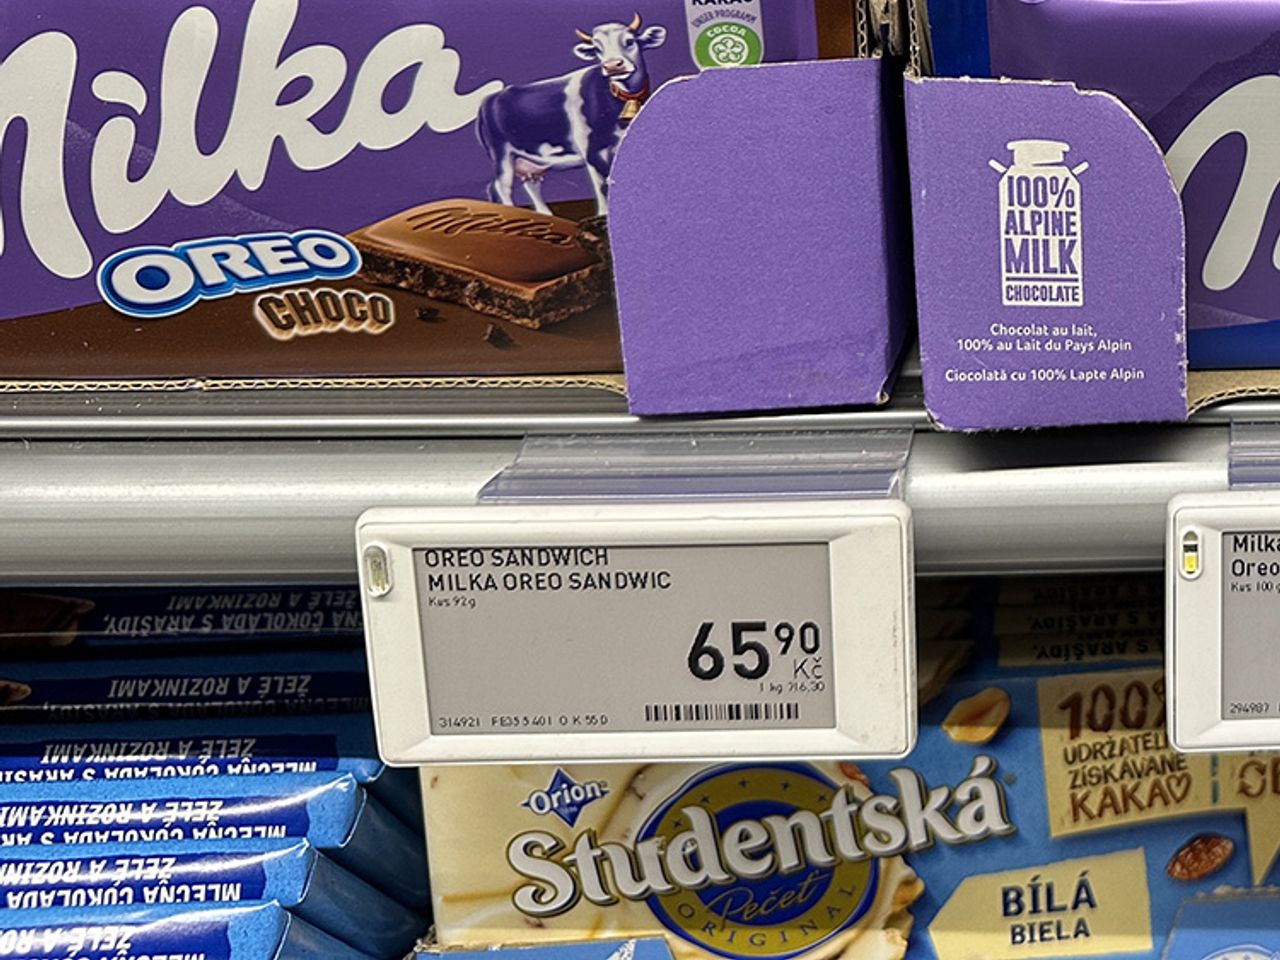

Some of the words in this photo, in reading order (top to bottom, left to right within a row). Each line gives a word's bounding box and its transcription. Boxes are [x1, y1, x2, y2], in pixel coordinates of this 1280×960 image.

[706, 24, 748, 38] COCOA
[1006, 175, 1076, 209] 100%
[1004, 210, 1077, 237] ALPINE
[1004, 238, 1078, 275] MILK
[111, 237, 343, 306] OREO
[1005, 284, 1080, 303] CHOCOLATE
[256, 292, 395, 334] CHOCO
[990, 322, 1049, 337] Chocolat
[1052, 326, 1069, 337] au
[1072, 323, 1097, 338] lait,
[956, 339, 994, 352] 100%
[996, 341, 1013, 352] au
[1016, 339, 1042, 352] Lait
[1045, 339, 1062, 352] du
[1065, 339, 1094, 355] Pays
[1097, 338, 1132, 354] Alpin
[945, 368, 1007, 382] Ciocolată
[1010, 371, 1027, 382] cu
[1030, 369, 1067, 382] 100%
[1070, 369, 1107, 384] Lapte
[1110, 368, 1145, 384] Alpin
[425, 548, 485, 567] OREO
[490, 547, 609, 567] SANDWICH
[1231, 558, 1280, 577] Oreo
[428, 572, 498, 591] MILKA
[503, 572, 563, 591] OREO
[568, 571, 672, 590] SANDWIC
[1230, 581, 1252, 593] Kus
[167, 592, 280, 611] ROZINKAMI
[687, 621, 770, 681] 65
[793, 656, 823, 680] Kč
[108, 676, 229, 698] ROZINKAMI
[238, 676, 249, 694] A
[257, 674, 312, 701] ŽELÉ
[439, 716, 480, 728] 314921
[41, 739, 169, 764] ROZINKAMI
[1063, 731, 1170, 766] UDRŽATEL
[0, 802, 131, 827] ROZINKAMI
[507, 755, 1014, 917] Studentská
[1001, 869, 1098, 919] BÍLÁ
[676, 881, 859, 949] ORIGINAL
[1010, 920, 1091, 946] BIELA
